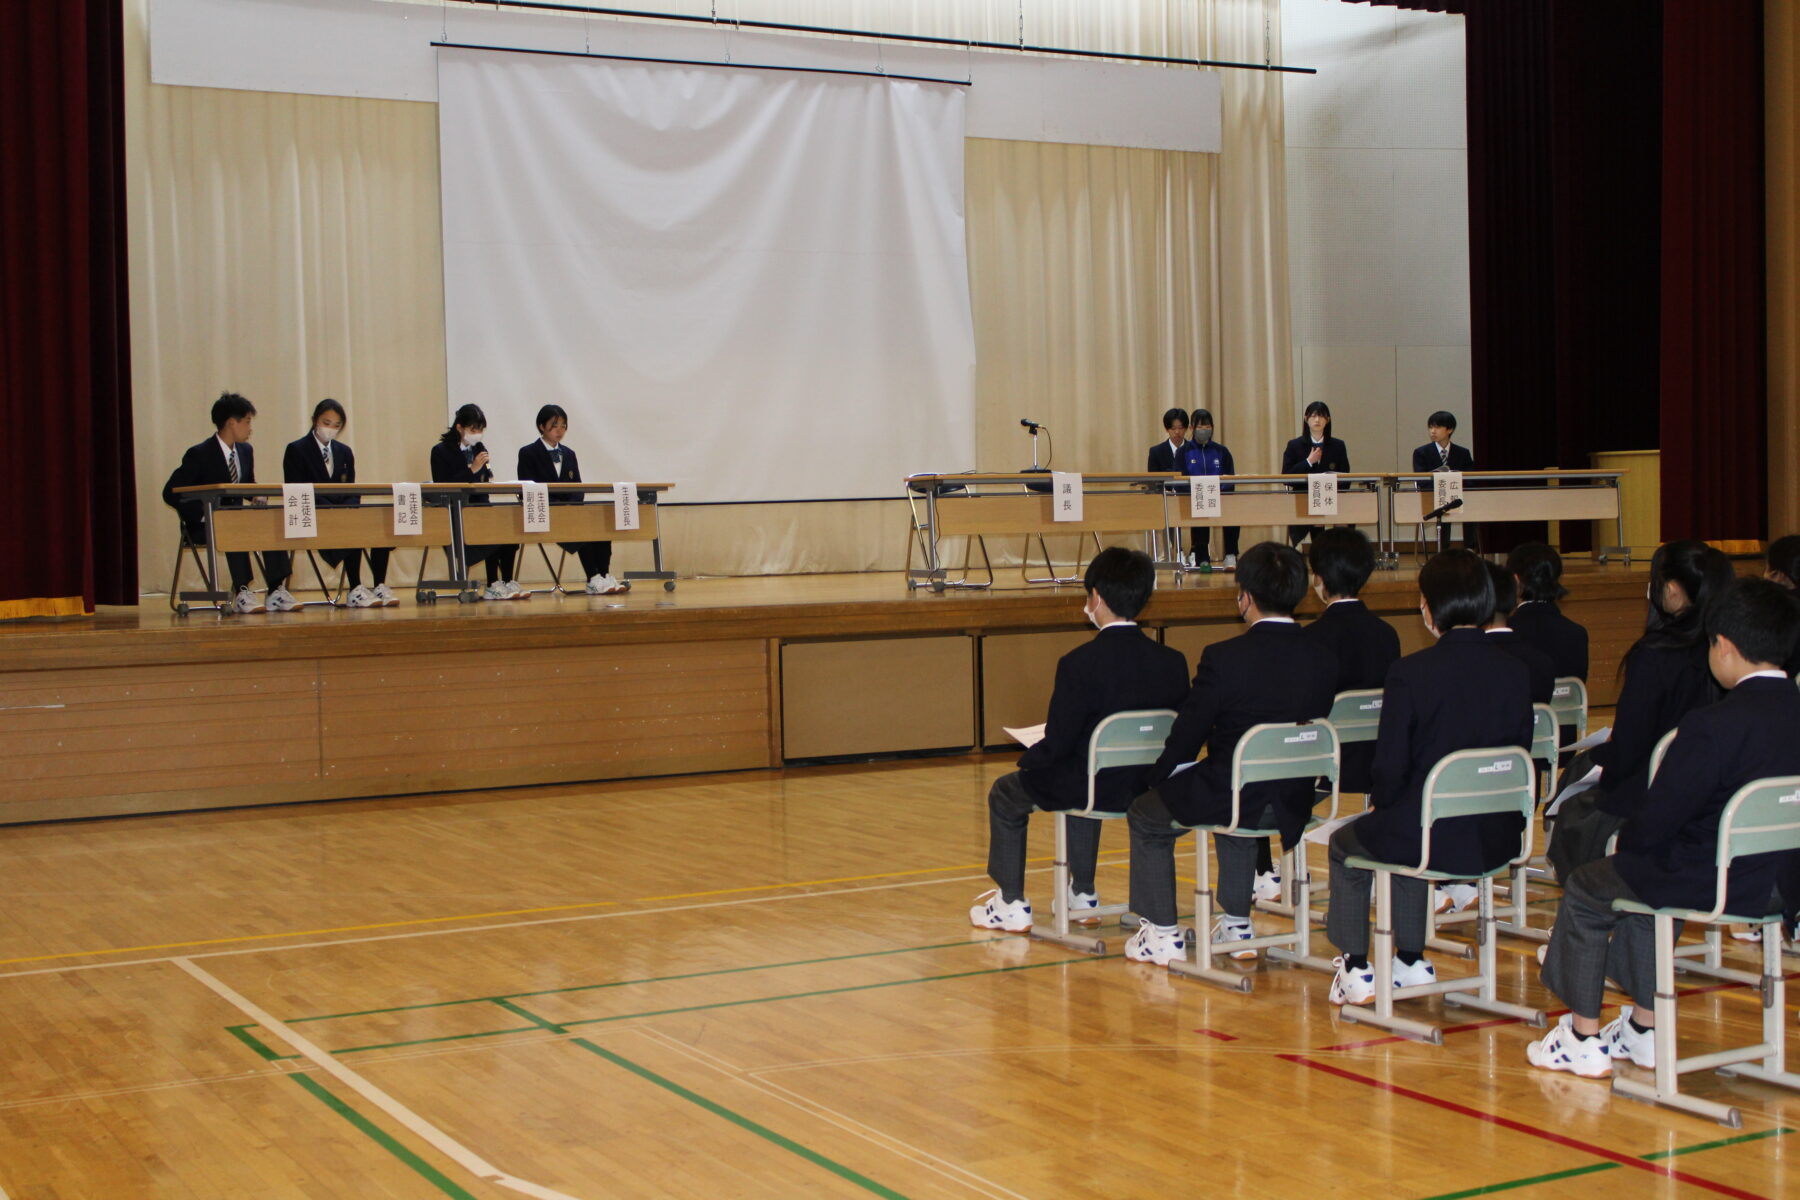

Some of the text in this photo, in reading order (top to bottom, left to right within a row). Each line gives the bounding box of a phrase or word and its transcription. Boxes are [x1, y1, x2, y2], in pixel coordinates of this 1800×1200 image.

[288, 495, 298, 526] 会計
[301, 493, 312, 528] 生徒会
[397, 494, 407, 524] 書記
[409, 493, 418, 526] 生徒会
[537, 492, 546, 523] 生徒会
[1062, 483, 1072, 511] 議長
